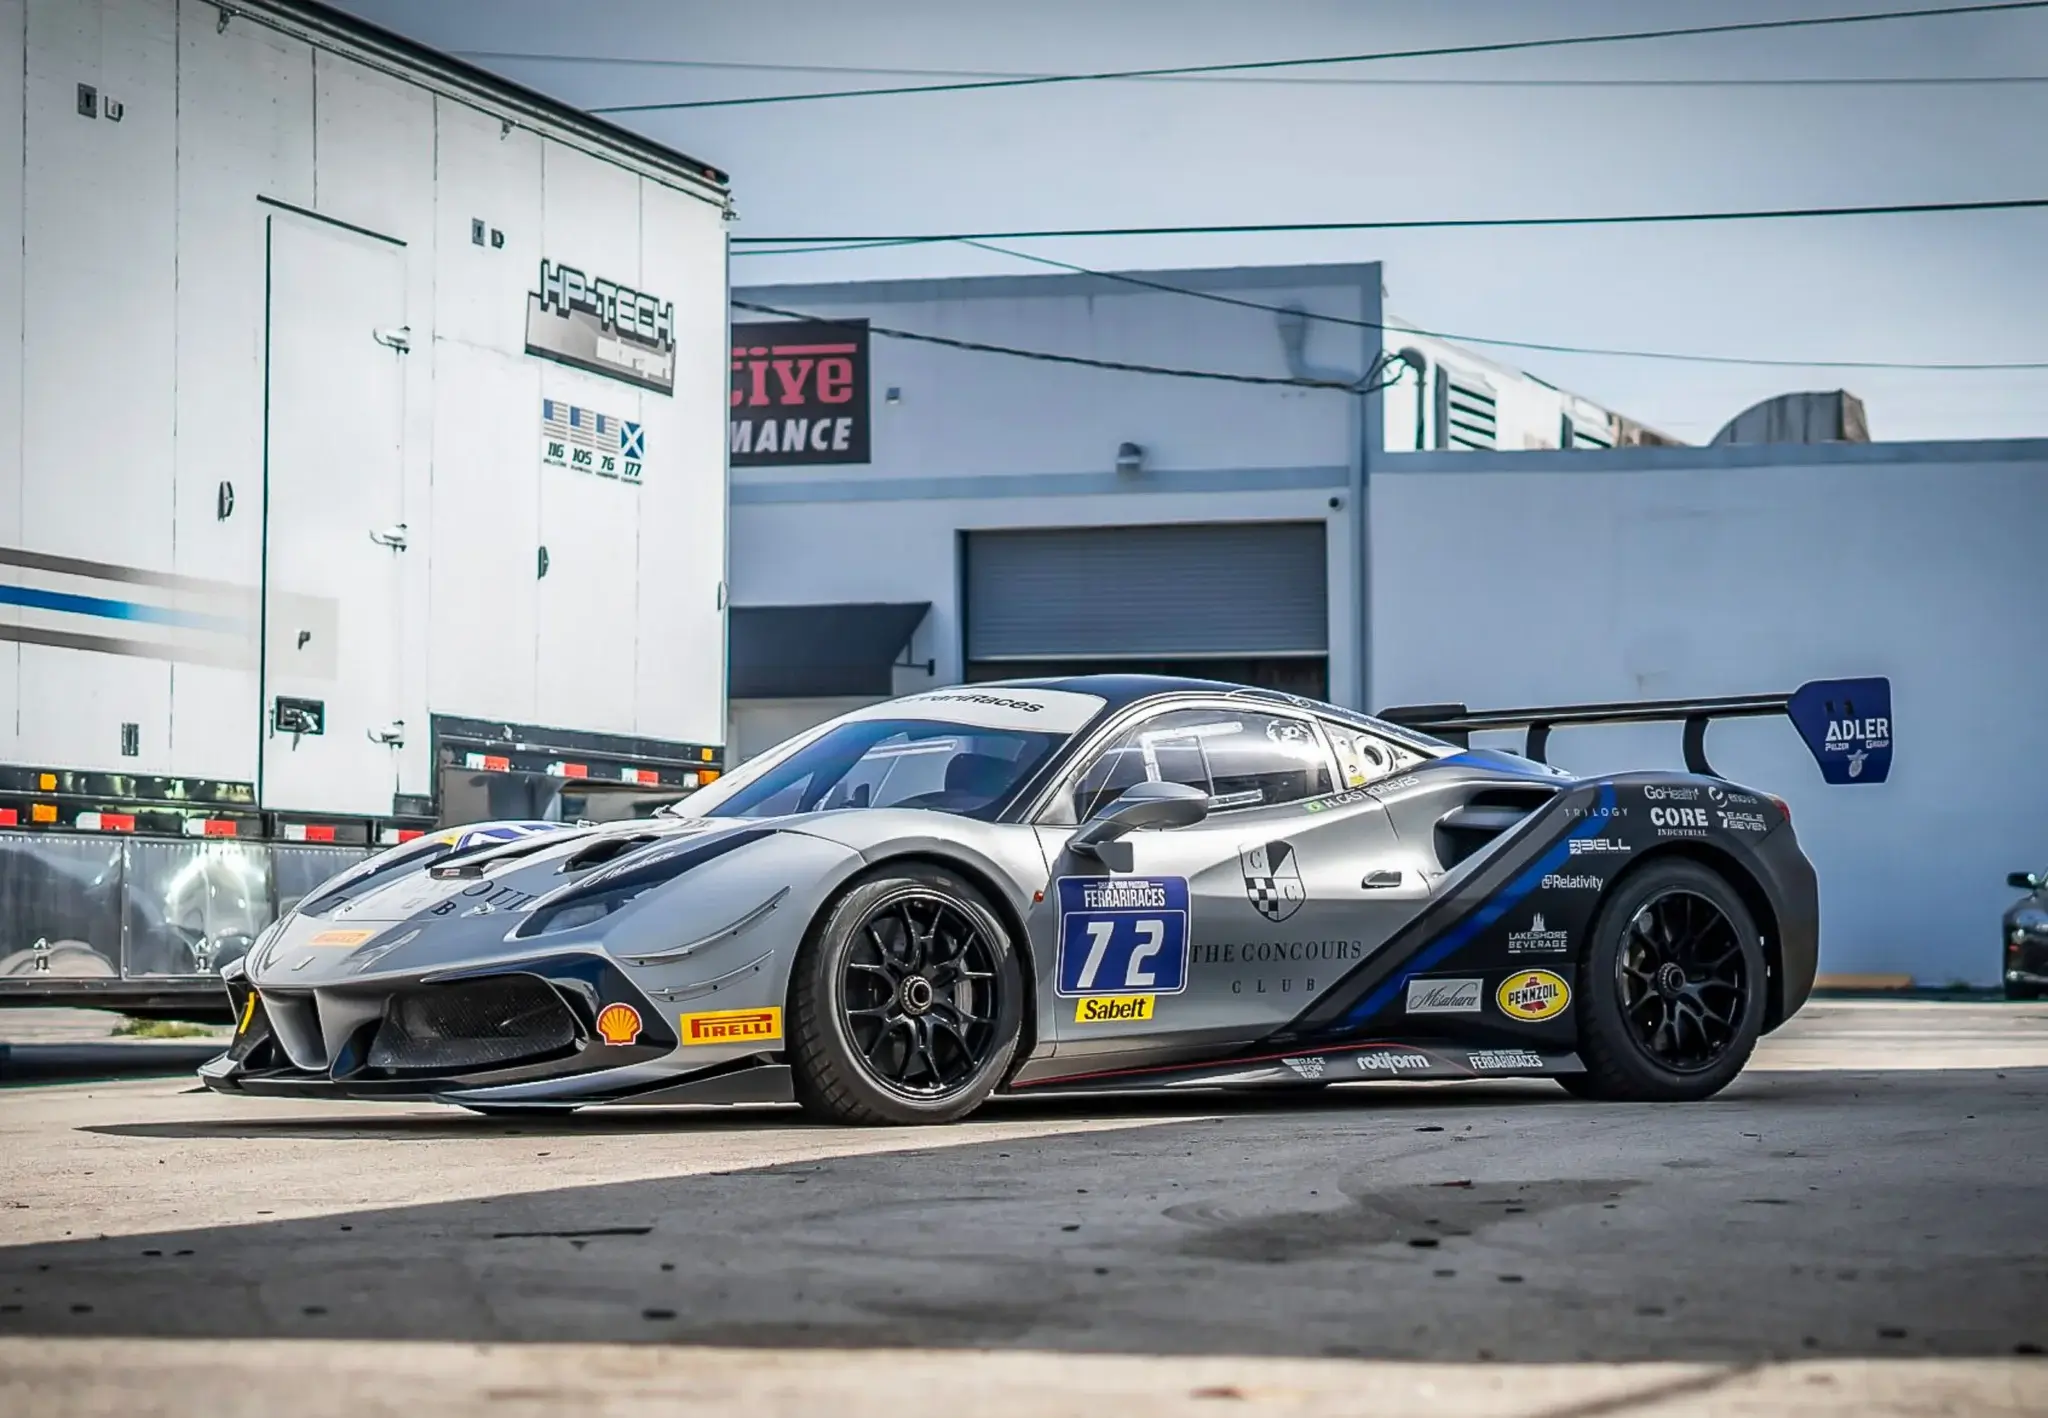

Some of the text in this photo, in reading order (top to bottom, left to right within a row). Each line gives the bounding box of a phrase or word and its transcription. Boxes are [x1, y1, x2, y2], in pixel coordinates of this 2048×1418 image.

[541, 258, 673, 351] HP-TECH
[572, 447, 592, 466] 105
[601, 455, 615, 471] 76
[624, 461, 642, 477] 177
[1825, 718, 1889, 741] ADLER
[1564, 807, 1628, 817] TRILOGY
[1650, 806, 1708, 826] CORE
[1727, 811, 1764, 822] EAGLE
[1657, 828, 1708, 836] INDUSTRIAL
[1729, 821, 1767, 831] SEVEN
[1581, 838, 1631, 850] BELL
[1553, 874, 1603, 892] Relativity
[1084, 888, 1165, 908] FERRARIRACES
[1508, 931, 1568, 940] LAKESHORE
[1508, 940, 1568, 949] BEVERAGE
[1077, 919, 1164, 988] 72
[1192, 940, 1362, 963] THE CONCOURS
[1232, 977, 1316, 994] CLUB
[1409, 982, 1478, 1009] Misahara
[1508, 983, 1560, 1006] PENNZOIL
[1084, 998, 1146, 1020] Sabelt
[691, 1014, 773, 1038] PIRELLI
[1300, 1056, 1326, 1065] RACE
[1357, 1051, 1431, 1074] rotiform
[1469, 1055, 1543, 1070] FERRARIRACES
